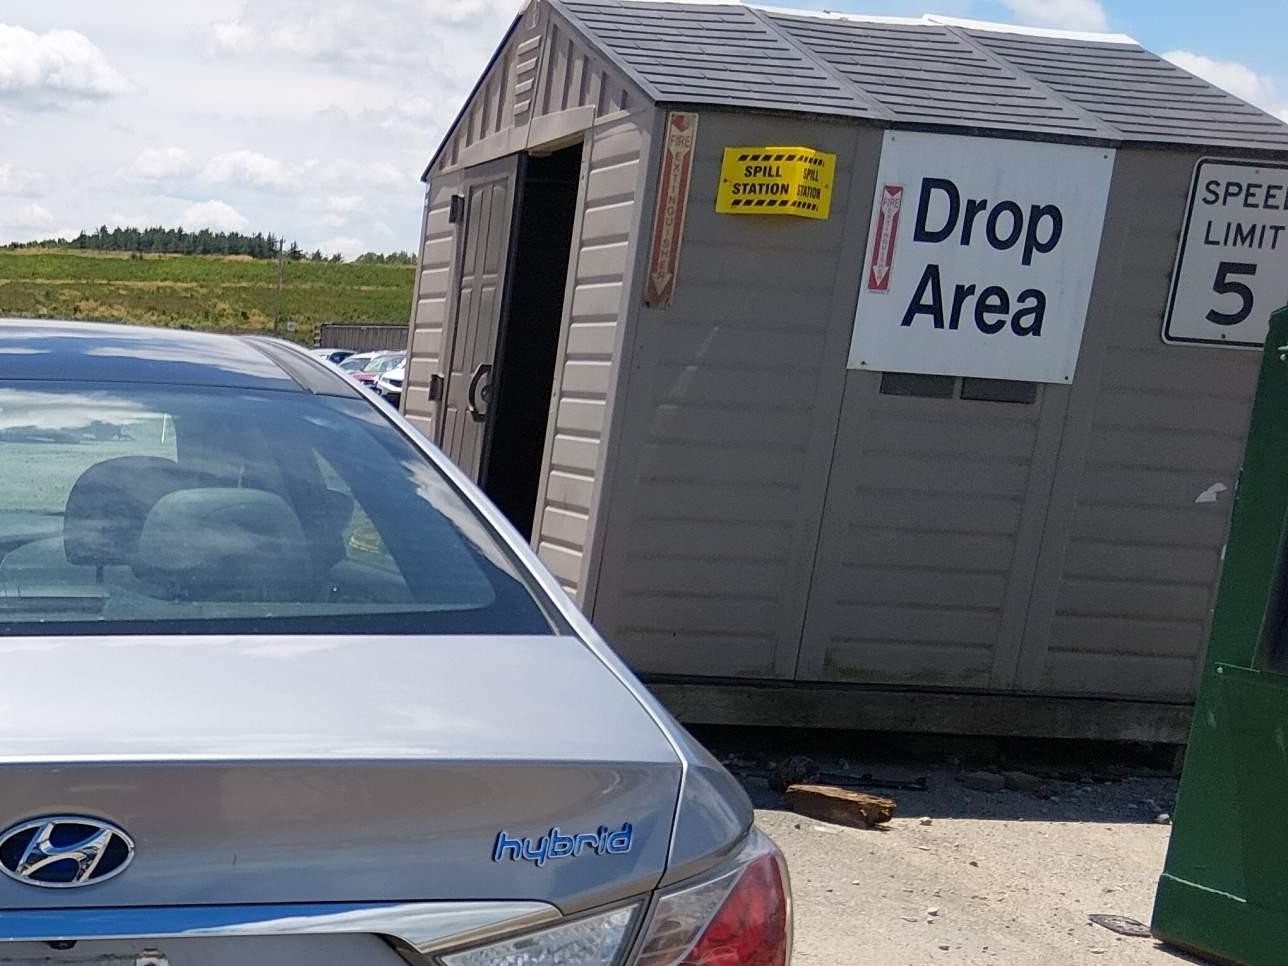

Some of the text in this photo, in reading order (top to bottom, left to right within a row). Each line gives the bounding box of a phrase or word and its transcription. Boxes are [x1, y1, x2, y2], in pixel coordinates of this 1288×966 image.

[670, 134, 692, 147] FIRE
[744, 165, 783, 178] SPILL
[802, 168, 819, 182] SPILL
[732, 183, 790, 195] STATION
[796, 185, 822, 200] STATION
[1202, 180, 1288, 211] SPEE
[913, 177, 1064, 266] Drop
[1204, 220, 1286, 250] LIMIT
[900, 264, 1047, 337] Area
[1205, 261, 1258, 326] 5
[492, 822, 633, 868] hybrid
